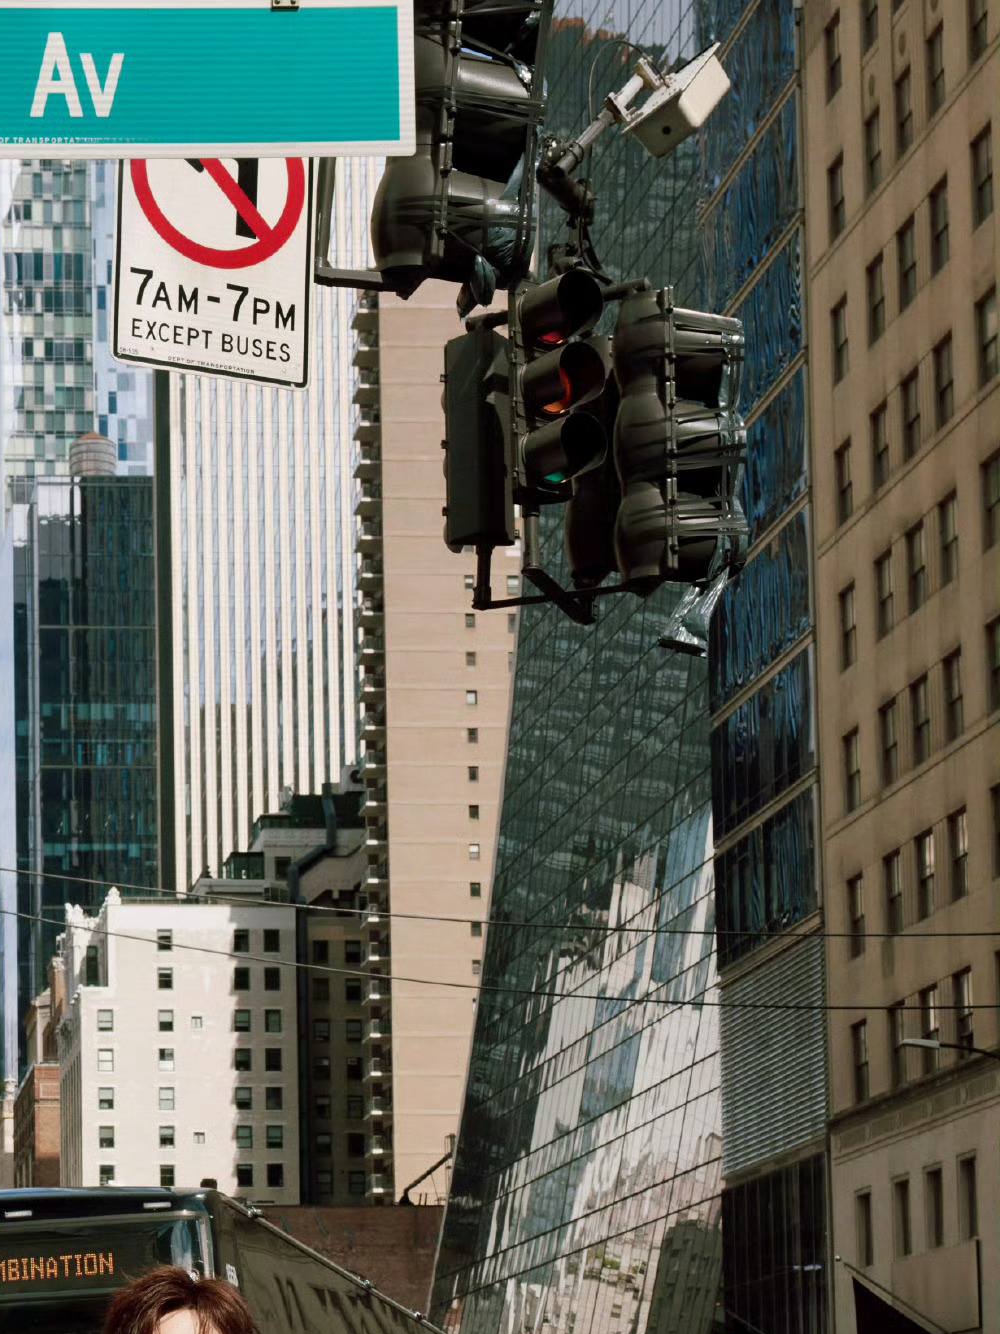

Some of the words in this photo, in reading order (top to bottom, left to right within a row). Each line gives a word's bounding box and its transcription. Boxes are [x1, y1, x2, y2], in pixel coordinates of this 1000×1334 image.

[0, 136, 10, 144] OF
[131, 317, 213, 350] EXCEPT
[221, 333, 291, 363] BUSES
[167, 355, 185, 363] DEPT
[197, 360, 255, 375] TRANSPORTATION
